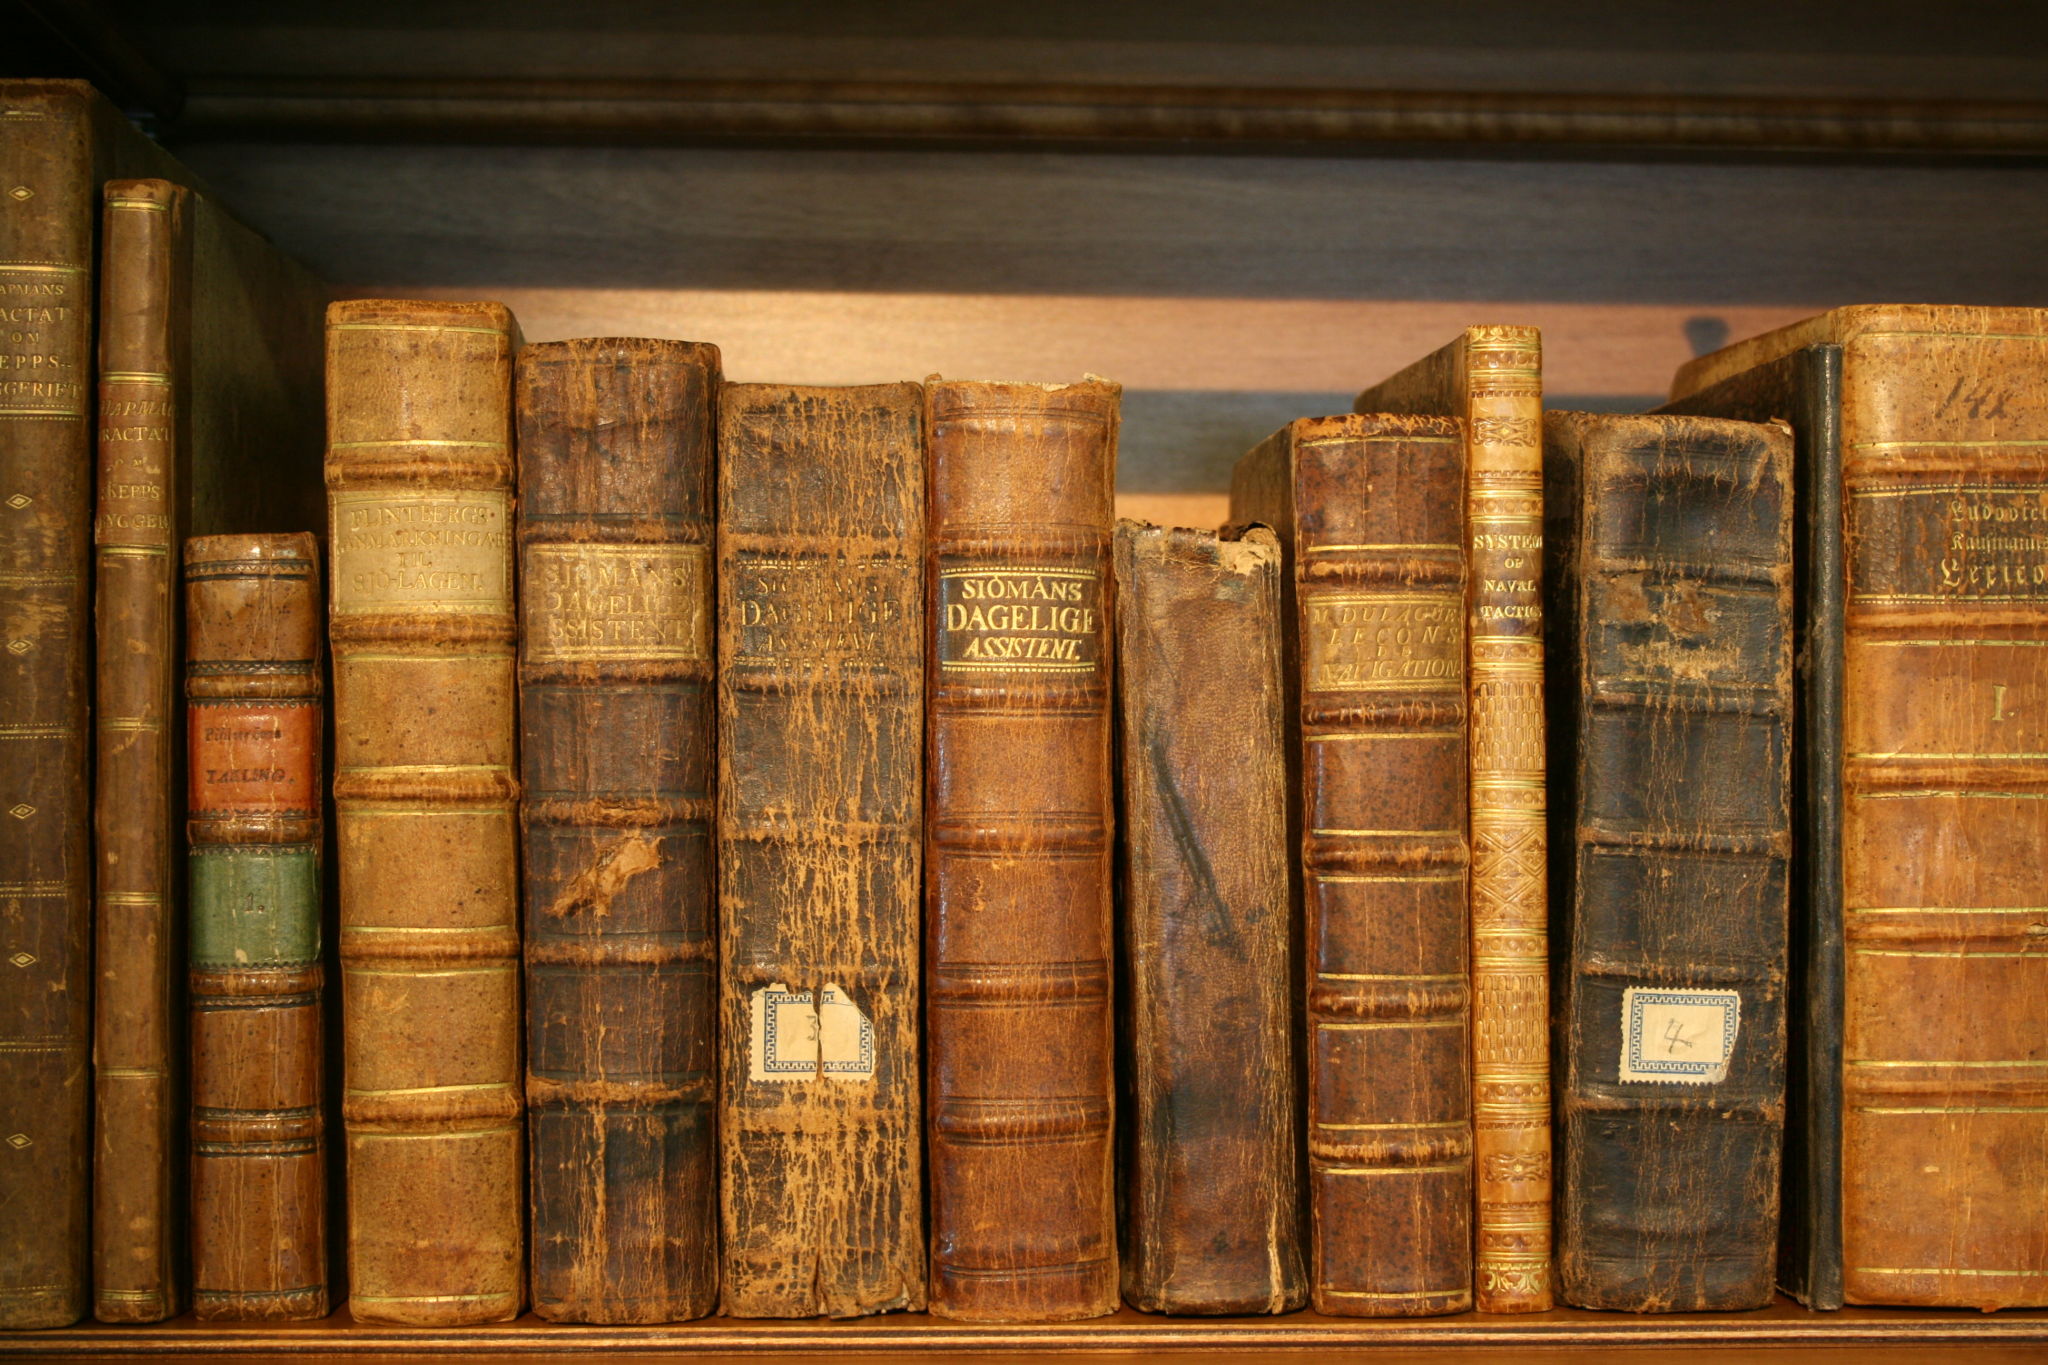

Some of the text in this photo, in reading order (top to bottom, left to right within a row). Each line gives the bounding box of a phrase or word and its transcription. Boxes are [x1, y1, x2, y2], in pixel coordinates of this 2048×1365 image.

[1473, 534, 1543, 550] SYSTEM
[1504, 557, 1524, 569] OF
[1484, 579, 1536, 593] NAVAL
[946, 604, 1096, 634] DAGELIGE
[962, 636, 1082, 661] ASSISTENT.
[1663, 1017, 1694, 1055] 4
